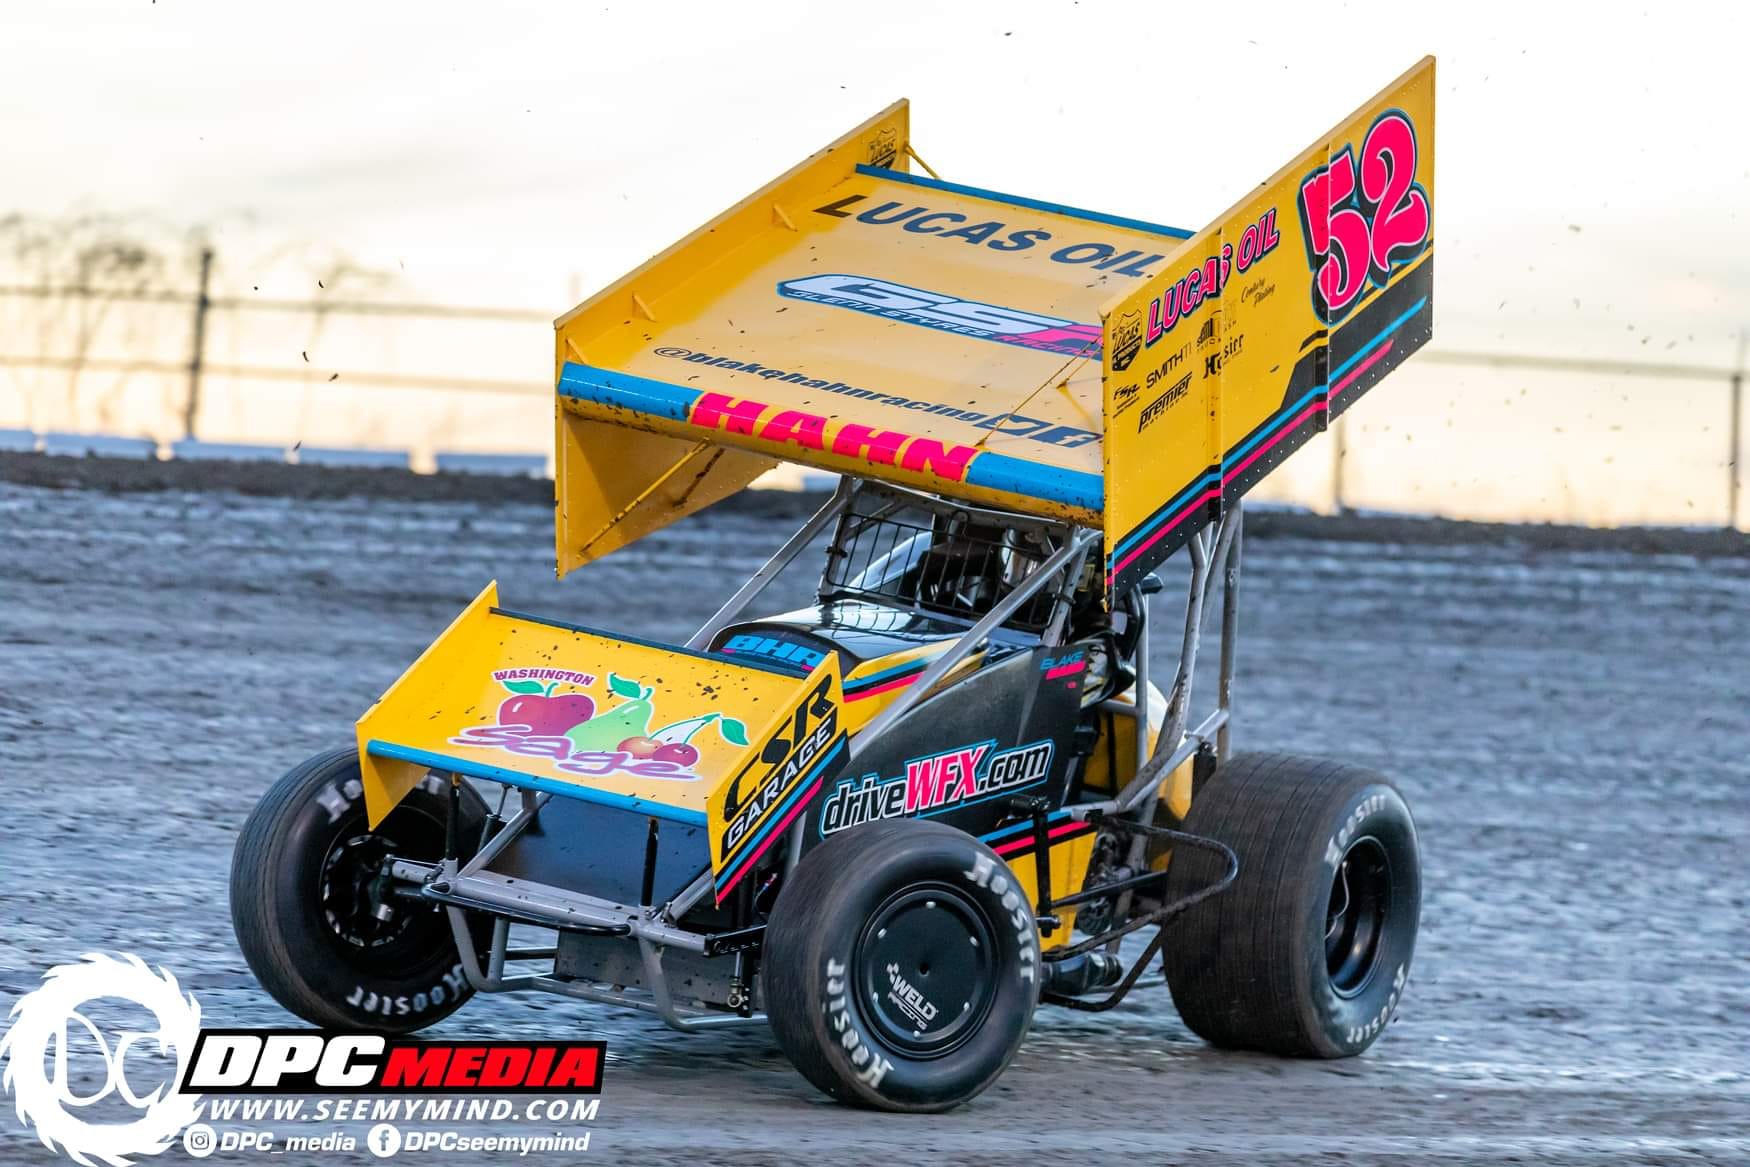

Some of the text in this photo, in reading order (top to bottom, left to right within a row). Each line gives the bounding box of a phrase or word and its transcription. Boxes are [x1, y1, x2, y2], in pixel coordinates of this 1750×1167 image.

[813, 195, 1166, 278] LUCAS OIL
[1299, 110, 1430, 326] 52
[1146, 245, 1232, 348] LUCAS
[1237, 207, 1280, 274] OIL
[654, 347, 992, 425] @blakehahnracing
[690, 392, 981, 480] HAHN
[494, 669, 594, 686] WASHINGTON
[727, 717, 832, 849] GARAGE
[822, 742, 1053, 838] driveWFX.com
[963, 851, 1035, 985] Hoosier
[347, 962, 471, 1016] Hoosier
[826, 957, 895, 1089] Hoosier
[893, 974, 937, 1021] WELD
